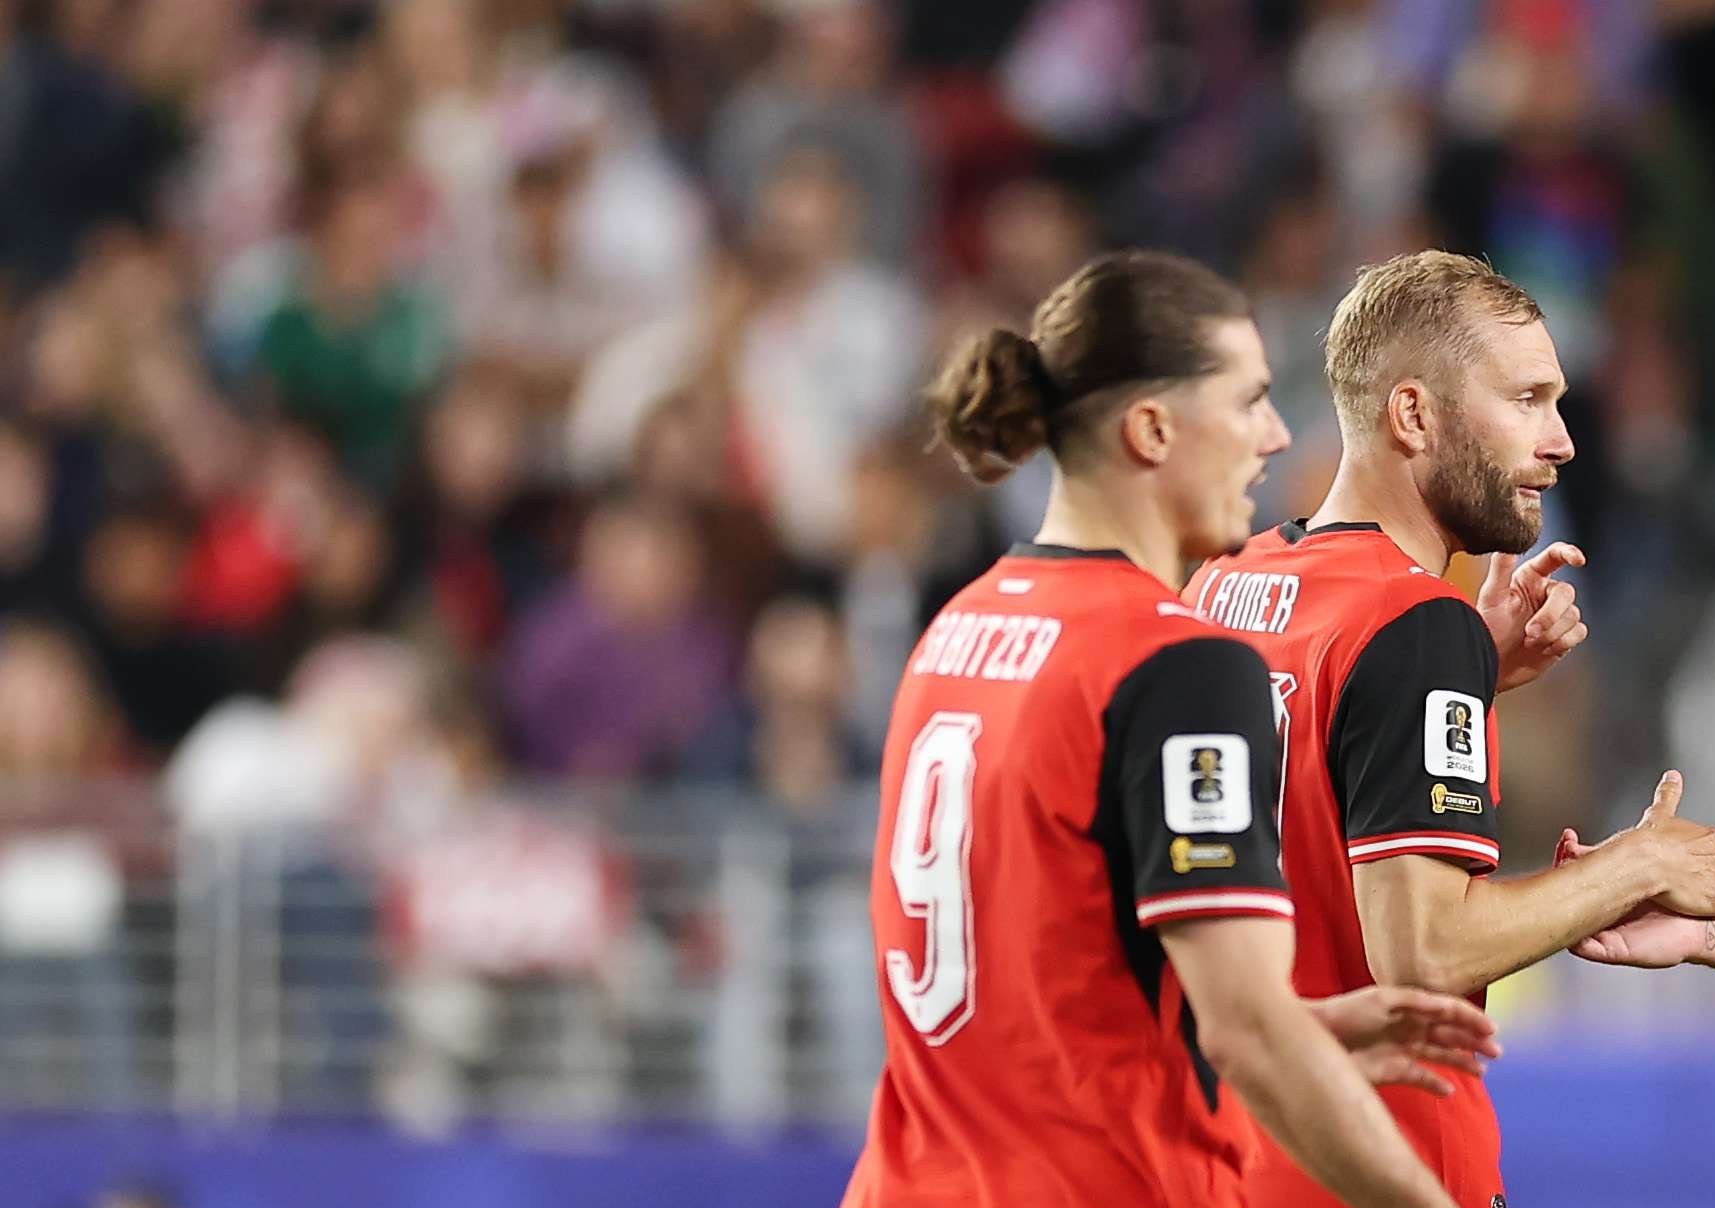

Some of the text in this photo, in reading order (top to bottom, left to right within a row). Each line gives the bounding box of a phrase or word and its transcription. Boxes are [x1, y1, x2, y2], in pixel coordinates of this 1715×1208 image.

[1193, 568, 1300, 634] LAIMER
[913, 612, 1062, 682] SABITZER
[1445, 796, 1478, 807] DEBUT
[886, 711, 984, 1047] 9
